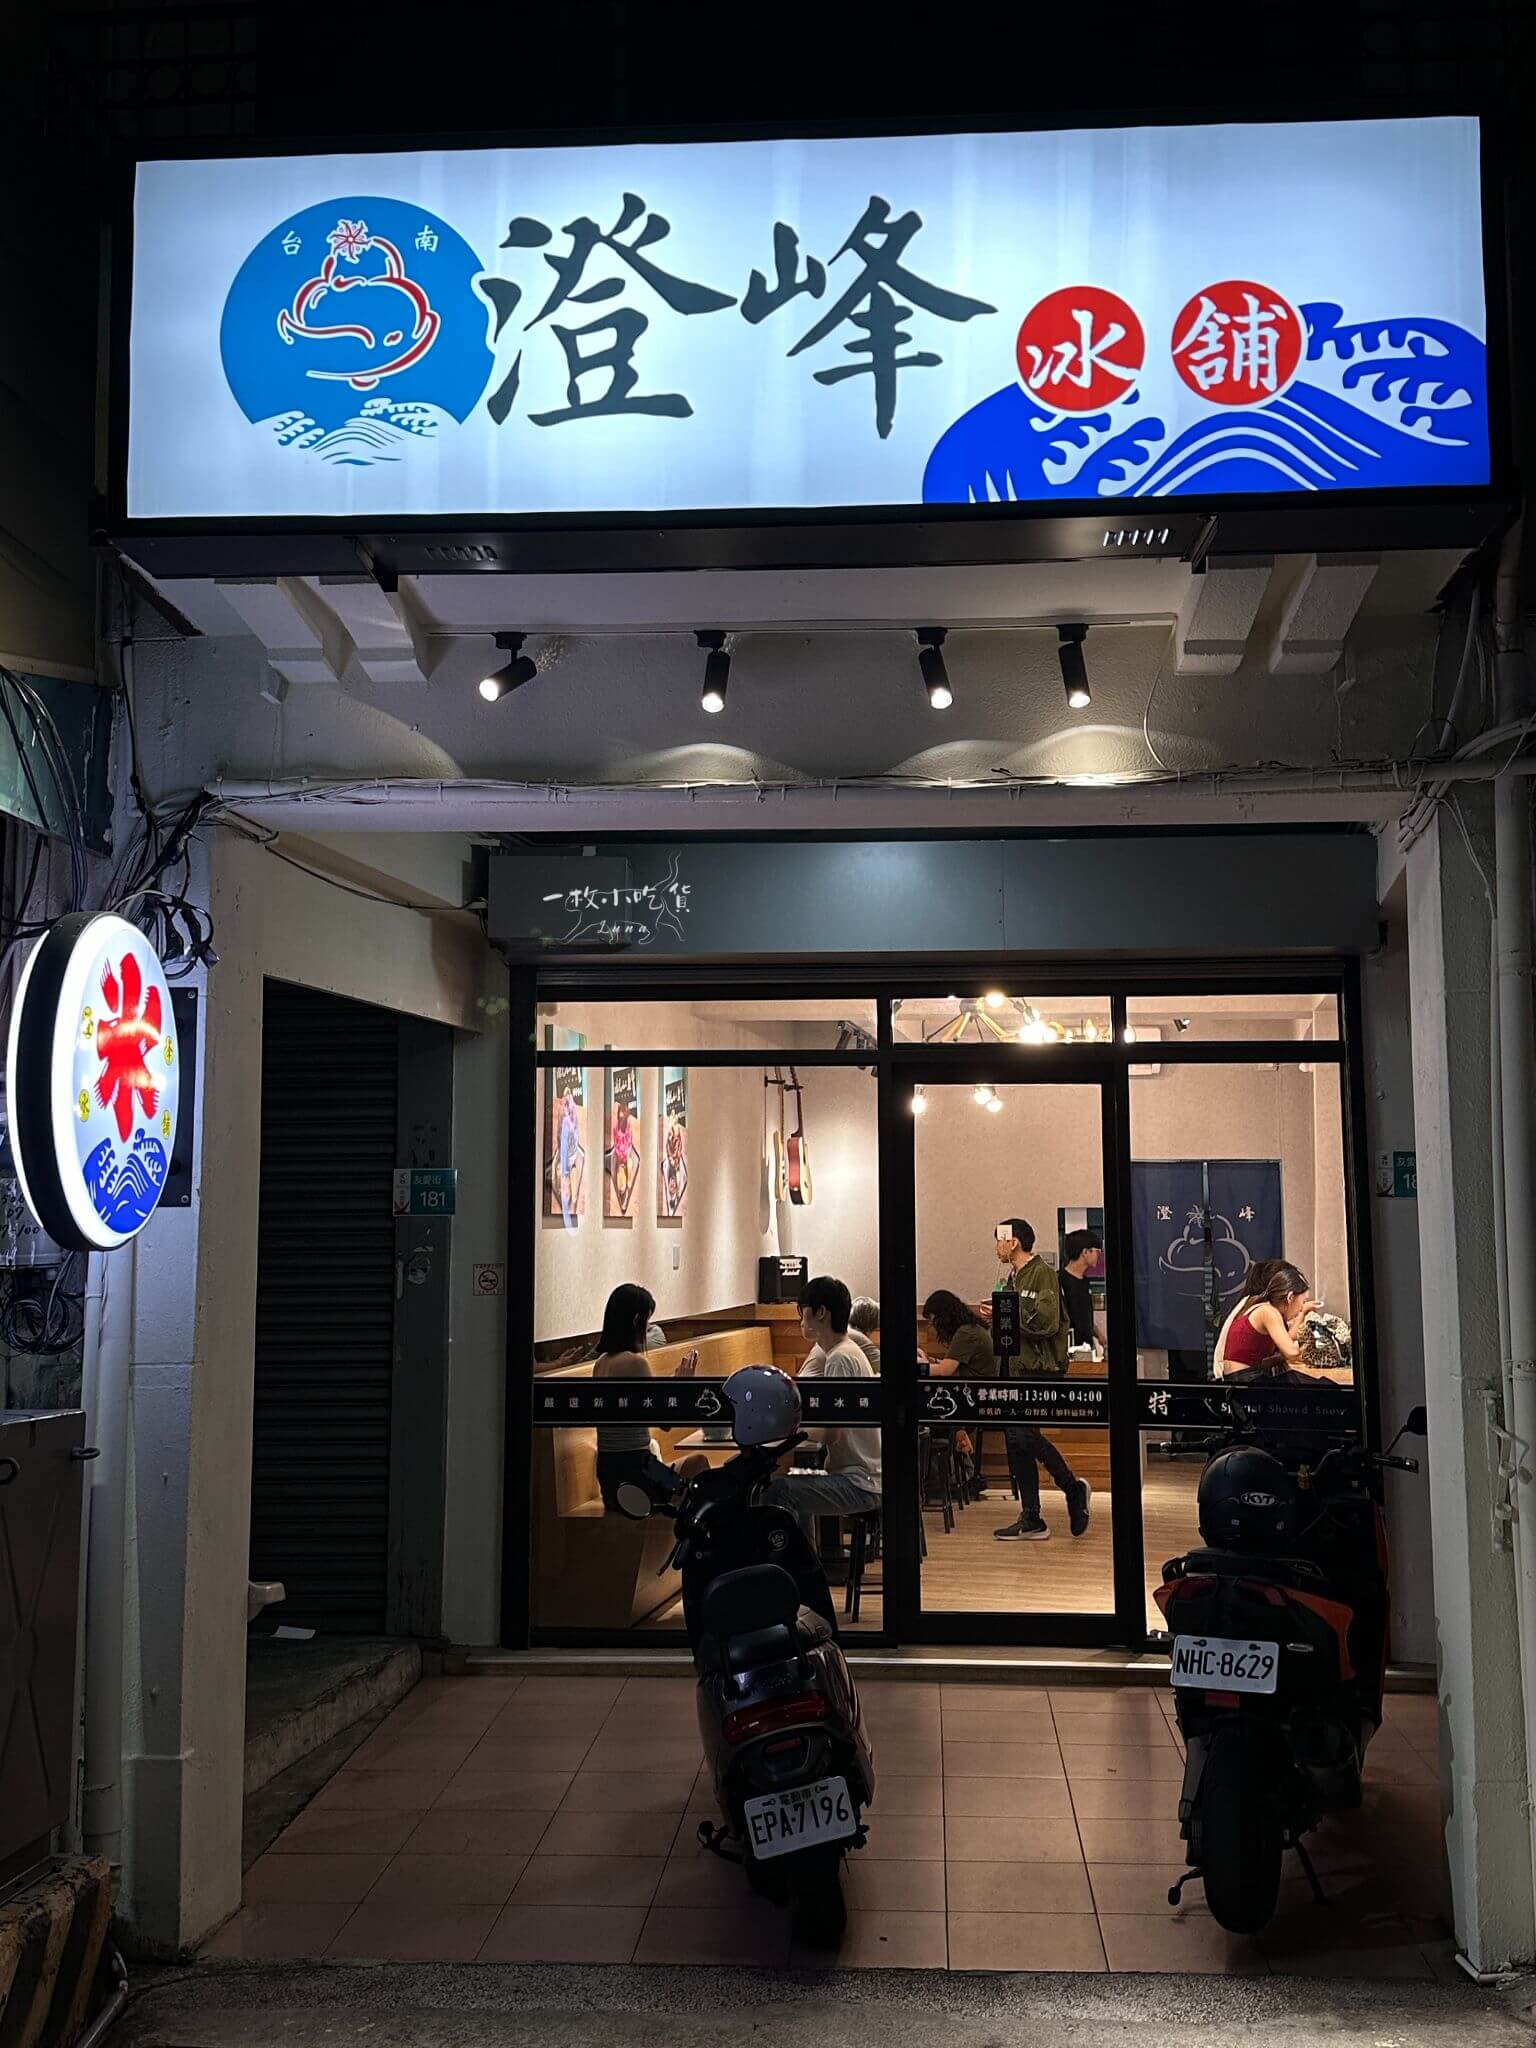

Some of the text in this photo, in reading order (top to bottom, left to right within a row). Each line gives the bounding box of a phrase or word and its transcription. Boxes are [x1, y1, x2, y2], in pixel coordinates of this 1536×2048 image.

[281, 224, 440, 257] 台 南
[480, 192, 998, 439] 澄峰
[420, 1190, 446, 1207] 181
[1156, 1205, 1256, 1222] 澄 峰
[999, 1297, 1013, 1349] 營業中
[543, 1395, 678, 1408] 嚴選新鮮水果
[1149, 1389, 1174, 1416] 特
